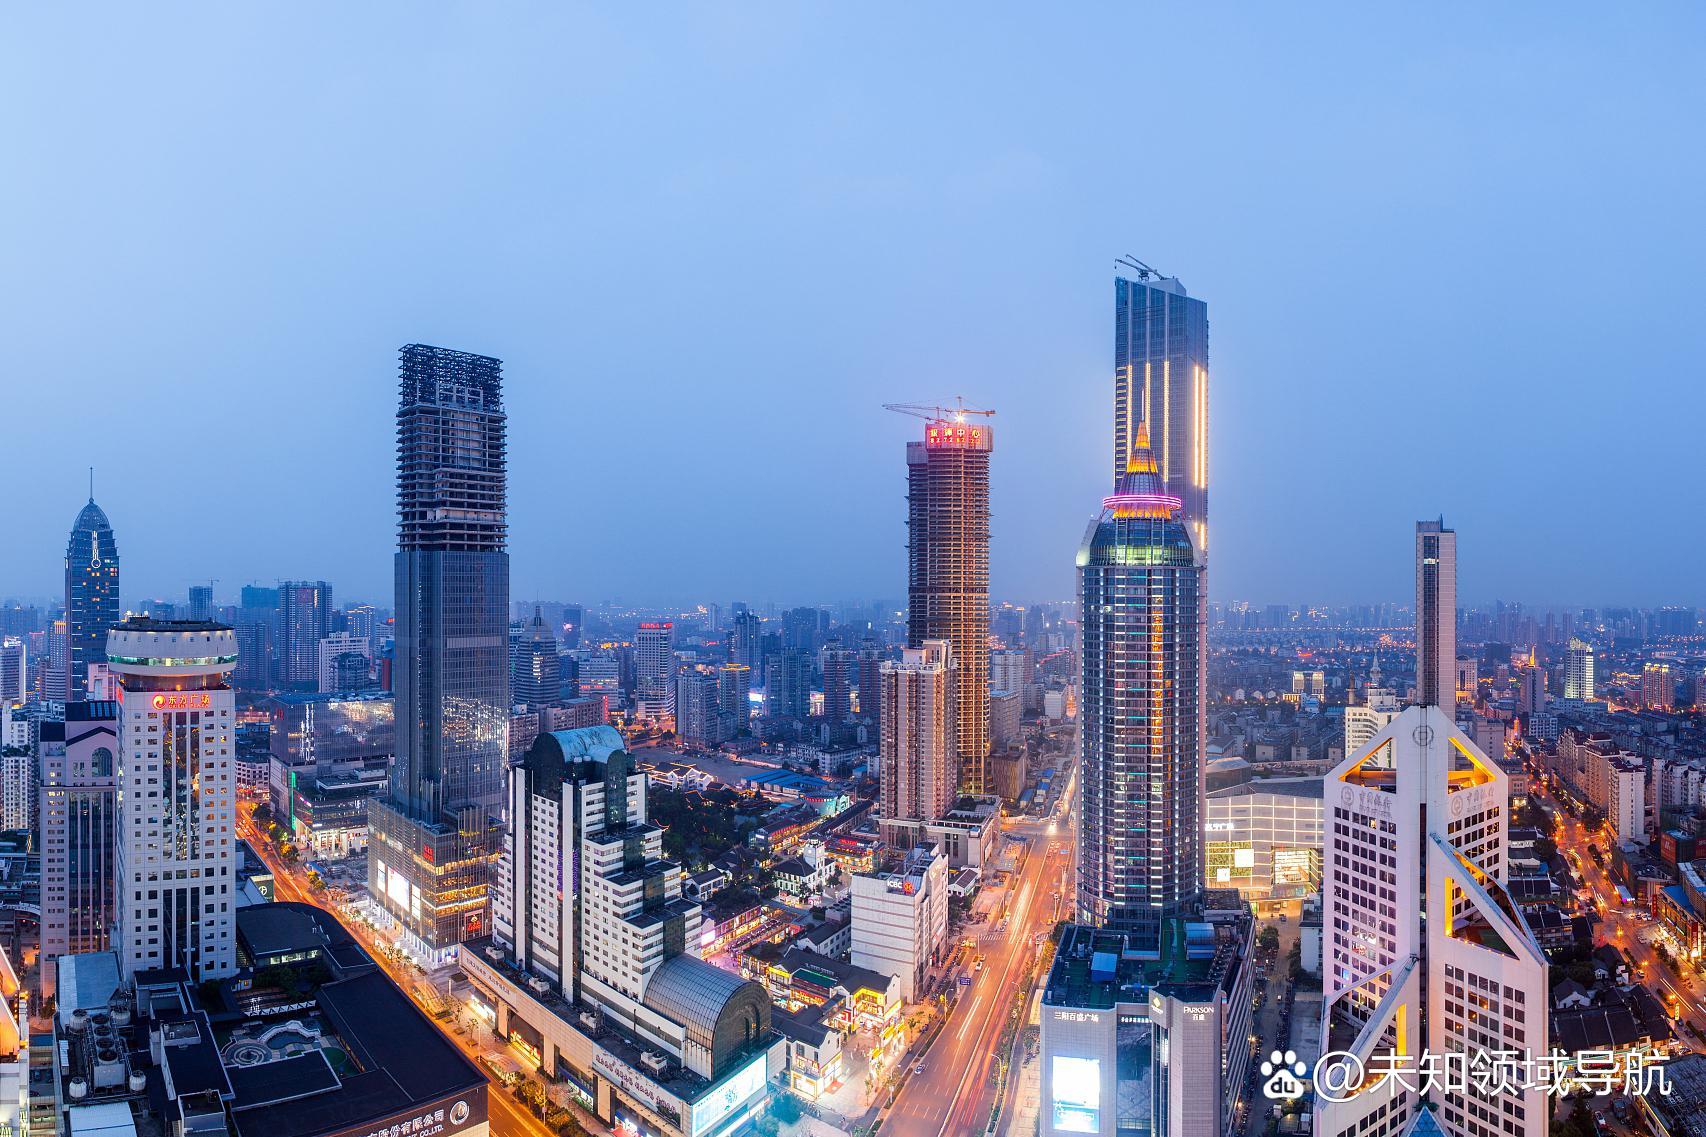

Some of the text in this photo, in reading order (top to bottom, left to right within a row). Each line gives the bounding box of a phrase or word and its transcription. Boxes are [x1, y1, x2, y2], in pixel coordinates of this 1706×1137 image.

[168, 694, 210, 704] 东方广场
[1183, 1006, 1214, 1014] PARKSON
[1054, 1011, 1099, 1022] 三阳百盛广场
